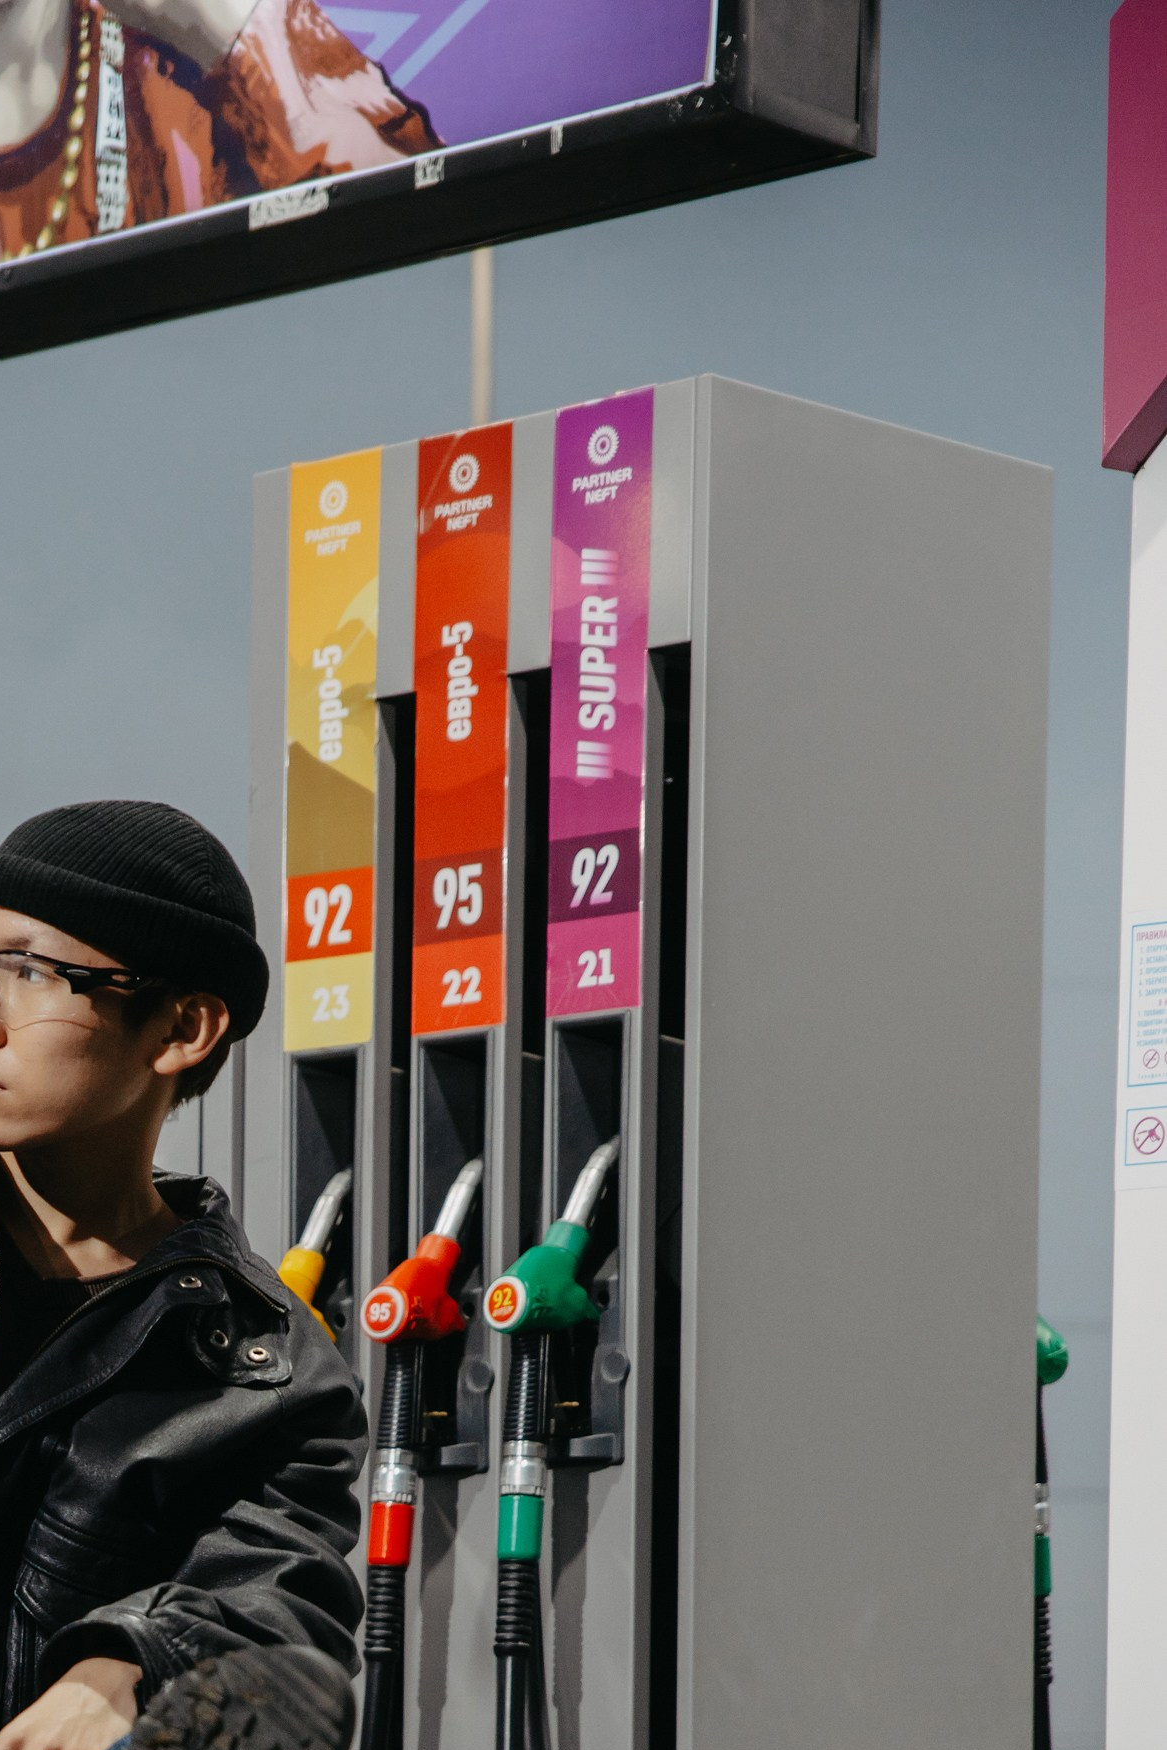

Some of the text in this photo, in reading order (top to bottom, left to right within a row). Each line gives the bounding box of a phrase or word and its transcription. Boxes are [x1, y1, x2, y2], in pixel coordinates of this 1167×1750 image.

[572, 467, 632, 493] PARTNER
[434, 495, 493, 519] PARTNER
[585, 486, 619, 505] NEFT
[305, 520, 361, 544] PARTNER
[446, 513, 479, 532] NEFT
[317, 538, 346, 556] NEFT
[570, 843, 620, 908] 92
[434, 863, 483, 930] 95
[304, 884, 352, 948] 92
[577, 948, 615, 989] 21
[441, 966, 482, 1008] 22
[312, 985, 351, 1022] 23
[493, 1288, 512, 1308] 92
[368, 1302, 392, 1323] 95
